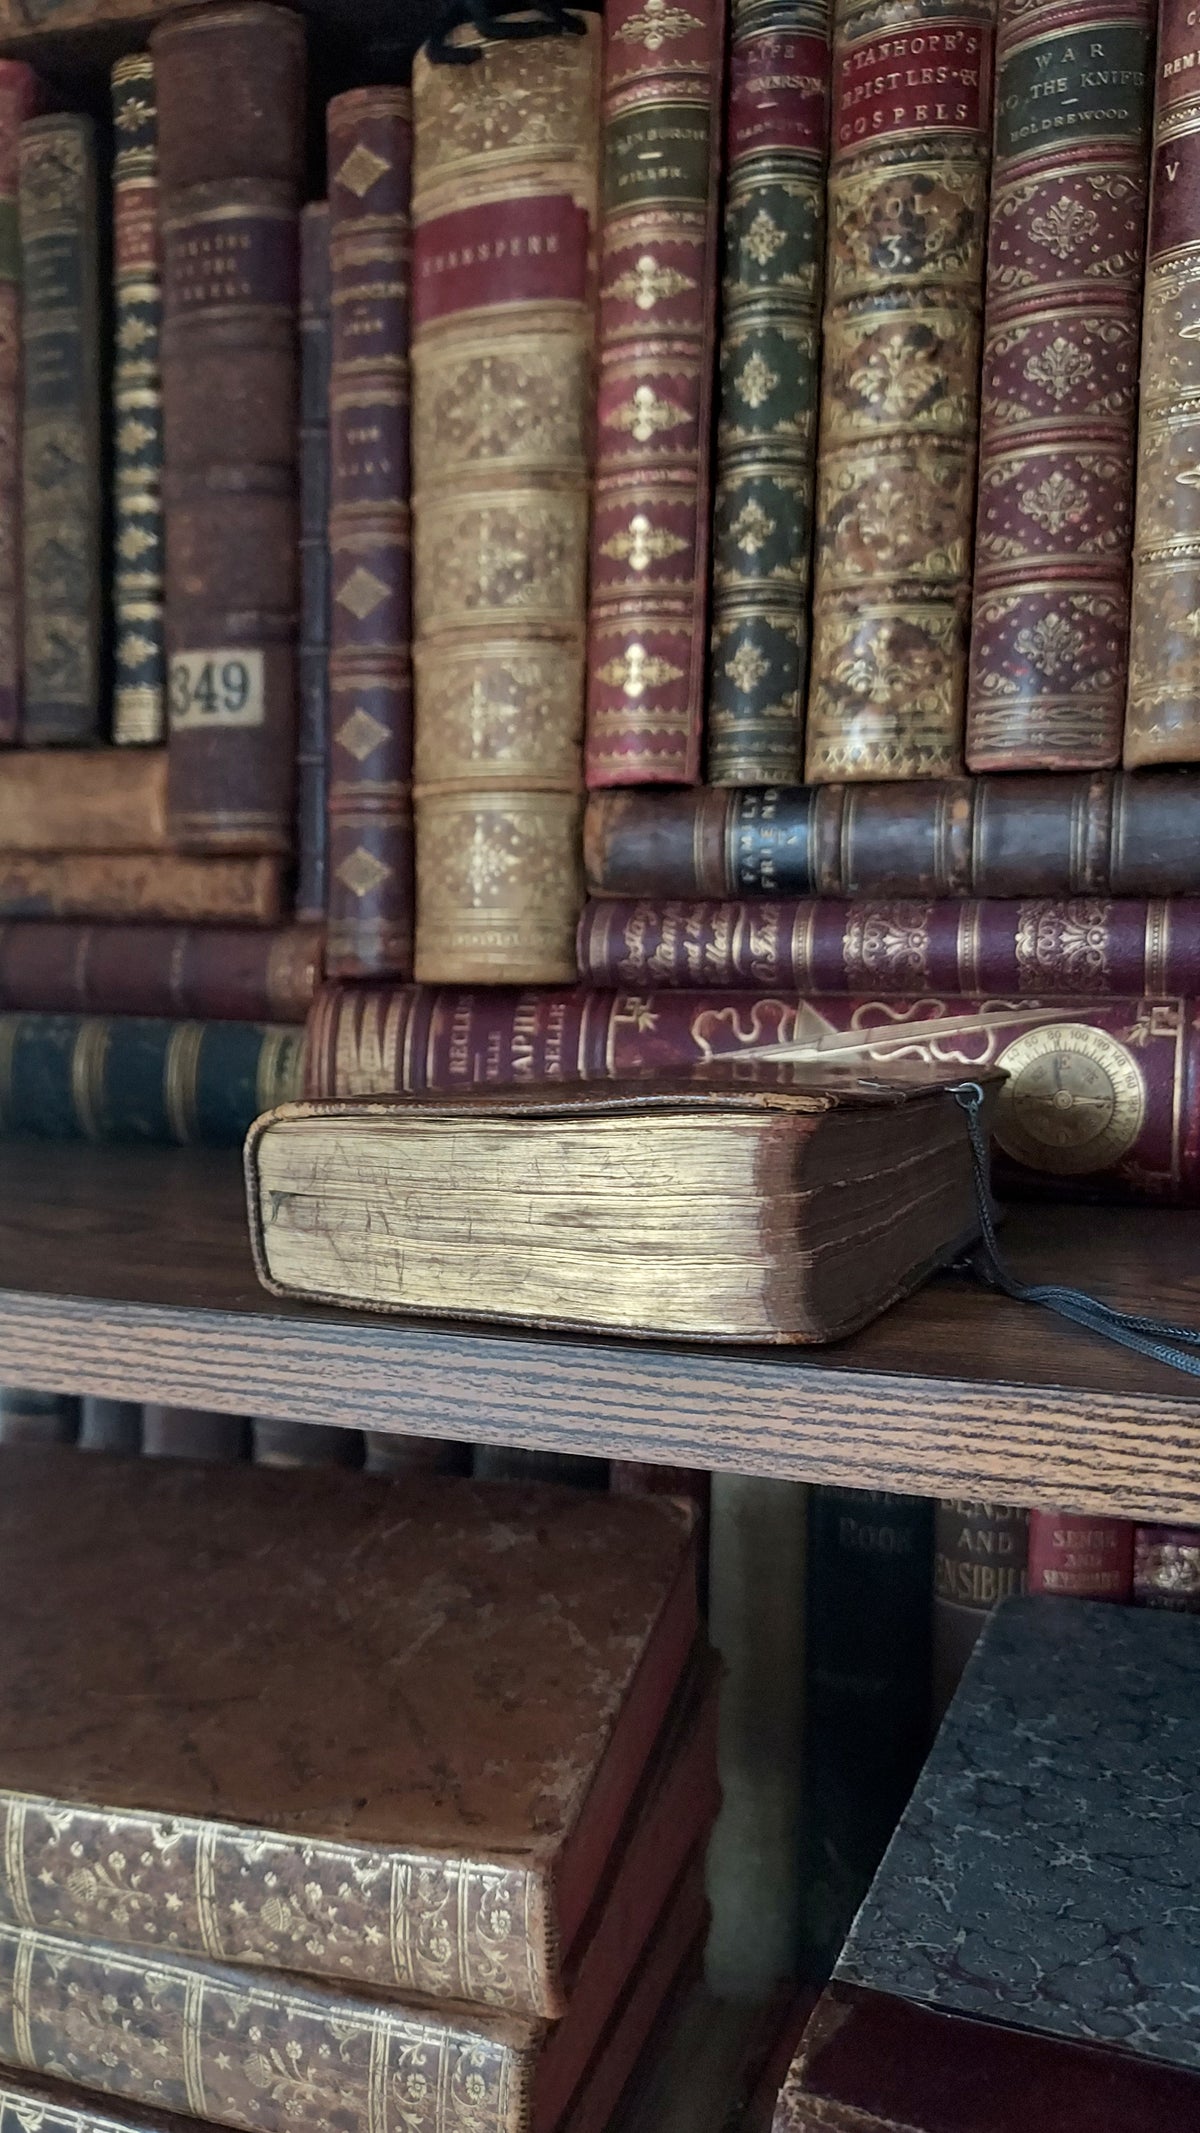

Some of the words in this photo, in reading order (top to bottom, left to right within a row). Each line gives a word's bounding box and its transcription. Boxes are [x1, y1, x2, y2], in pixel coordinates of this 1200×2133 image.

[1187, 10, 1200, 26] C
[841, 31, 978, 76] STANHOPE'S
[1035, 43, 1105, 68] WAR
[1030, 78, 1068, 99] THE
[1080, 71, 1144, 87] KNIFE
[840, 104, 968, 140] GOSPELS
[170, 660, 249, 716] 349
[741, 794, 757, 882] FAMILY
[760, 788, 778, 889] FRIEND
[1070, 1030, 1089, 1042] 100
[1056, 1055, 1071, 1070] E
[1111, 1051, 1127, 1067] 140
[958, 1527, 1014, 1553] AND
